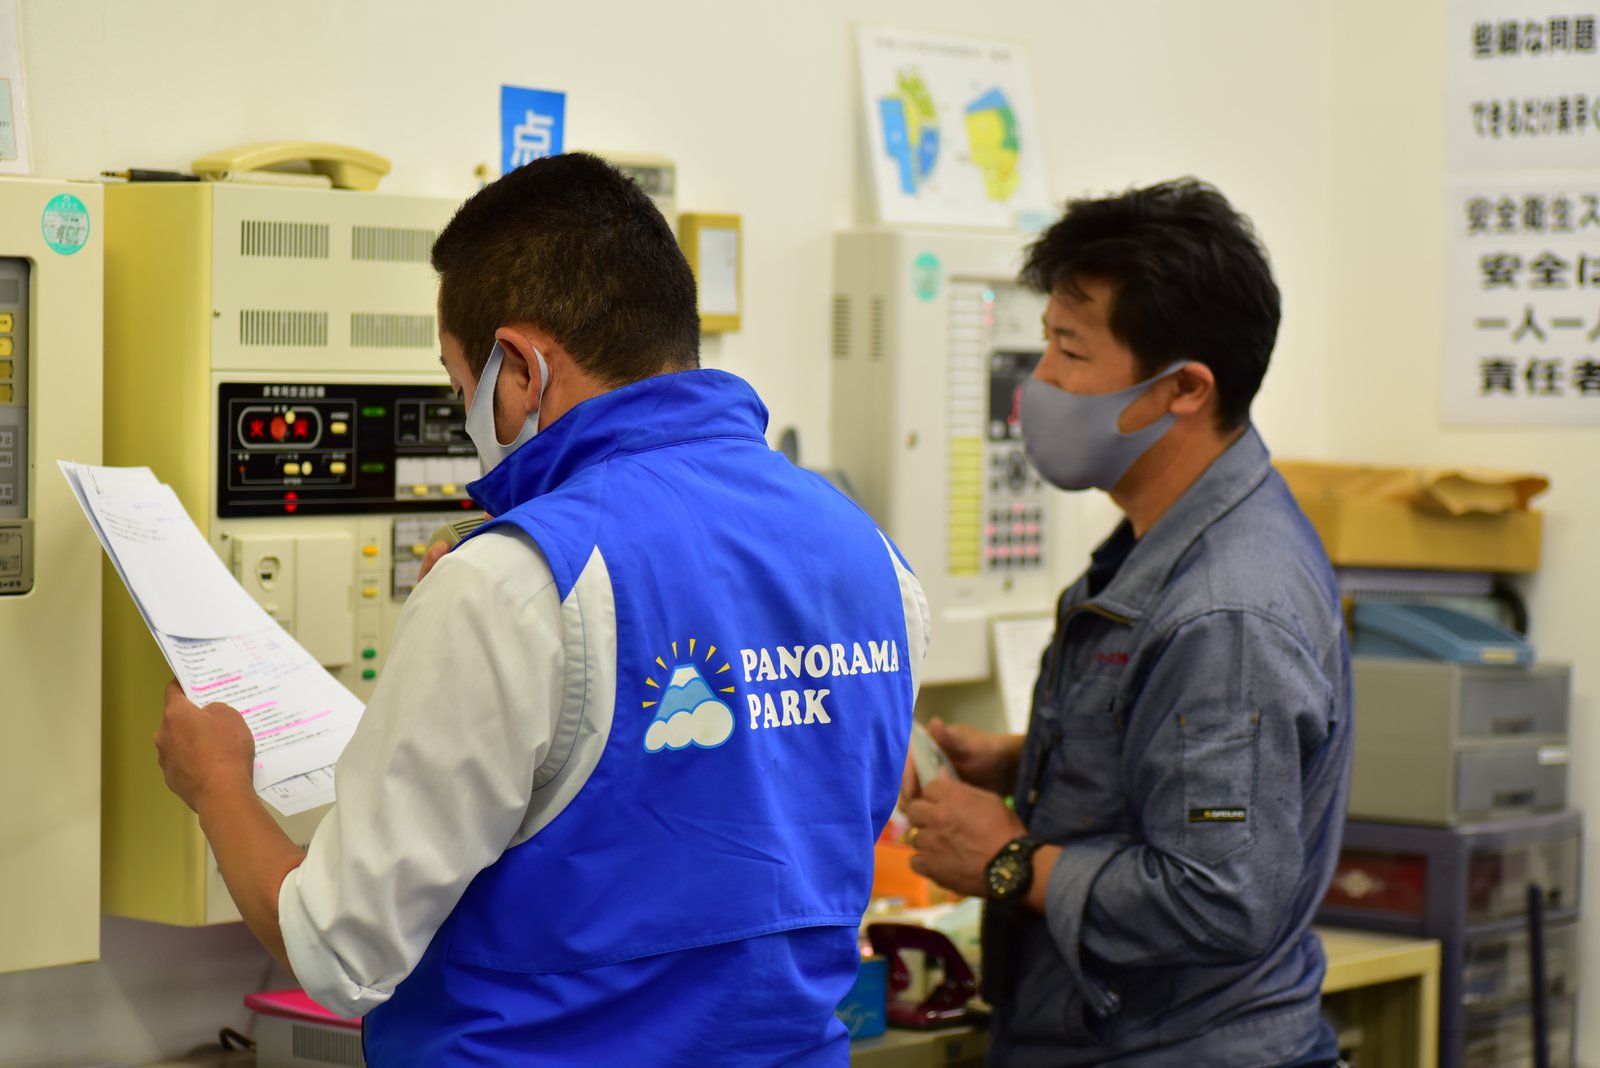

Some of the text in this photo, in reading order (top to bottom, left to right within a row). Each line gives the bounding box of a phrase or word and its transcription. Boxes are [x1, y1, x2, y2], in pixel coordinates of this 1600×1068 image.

[1479, 356, 1600, 398] 責任者
[740, 640, 899, 682] PANORAMA
[747, 689, 831, 730] PARK
